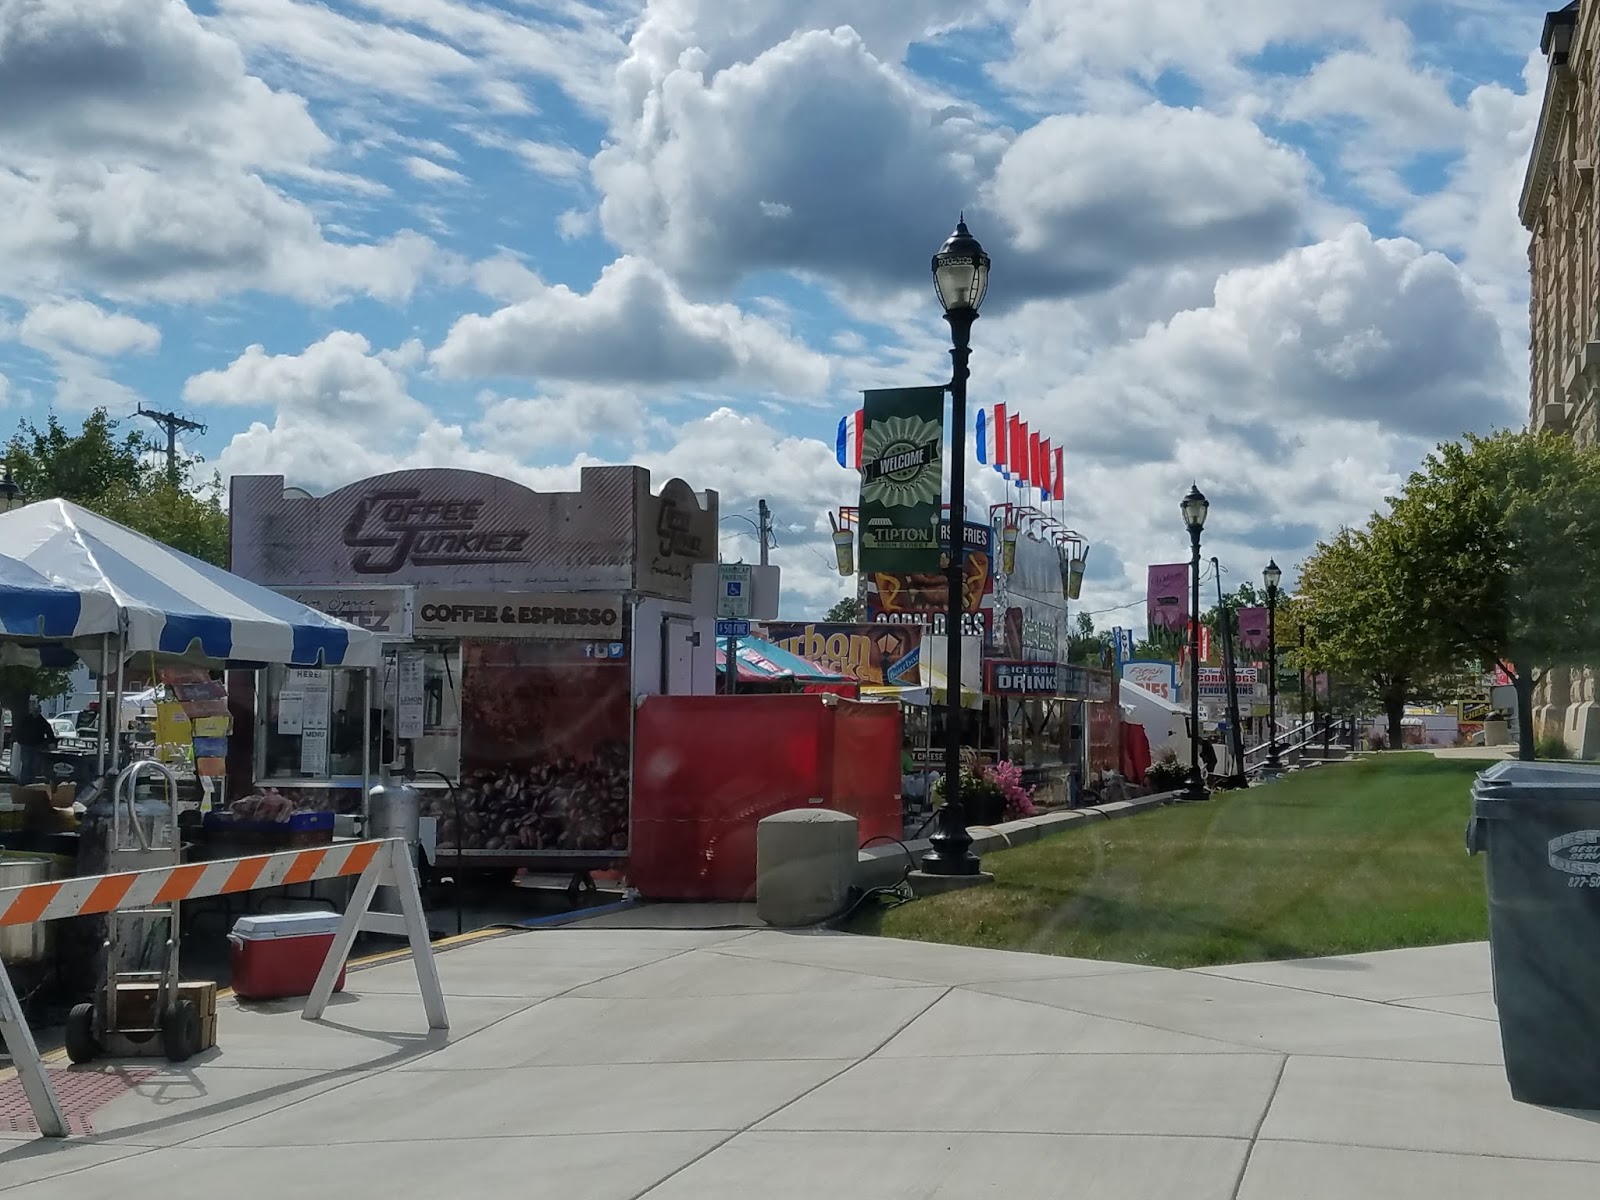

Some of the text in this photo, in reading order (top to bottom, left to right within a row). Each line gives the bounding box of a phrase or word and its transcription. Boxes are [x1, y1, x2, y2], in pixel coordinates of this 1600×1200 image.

[880, 449, 924, 474] WELCOME
[344, 488, 485, 548] COFFEE
[875, 528, 930, 541] TIPTON
[963, 527, 988, 546] FRIES
[354, 525, 532, 574] JUNKIEZ
[329, 591, 377, 615] Spice
[421, 604, 617, 626] COFFEE & ESPRESSO
[934, 613, 985, 635] DGS
[1011, 666, 1056, 674] ICE COLD
[1236, 674, 1256, 682] OGS
[998, 674, 1058, 690] DRINKS
[917, 752, 944, 761] CHESE
